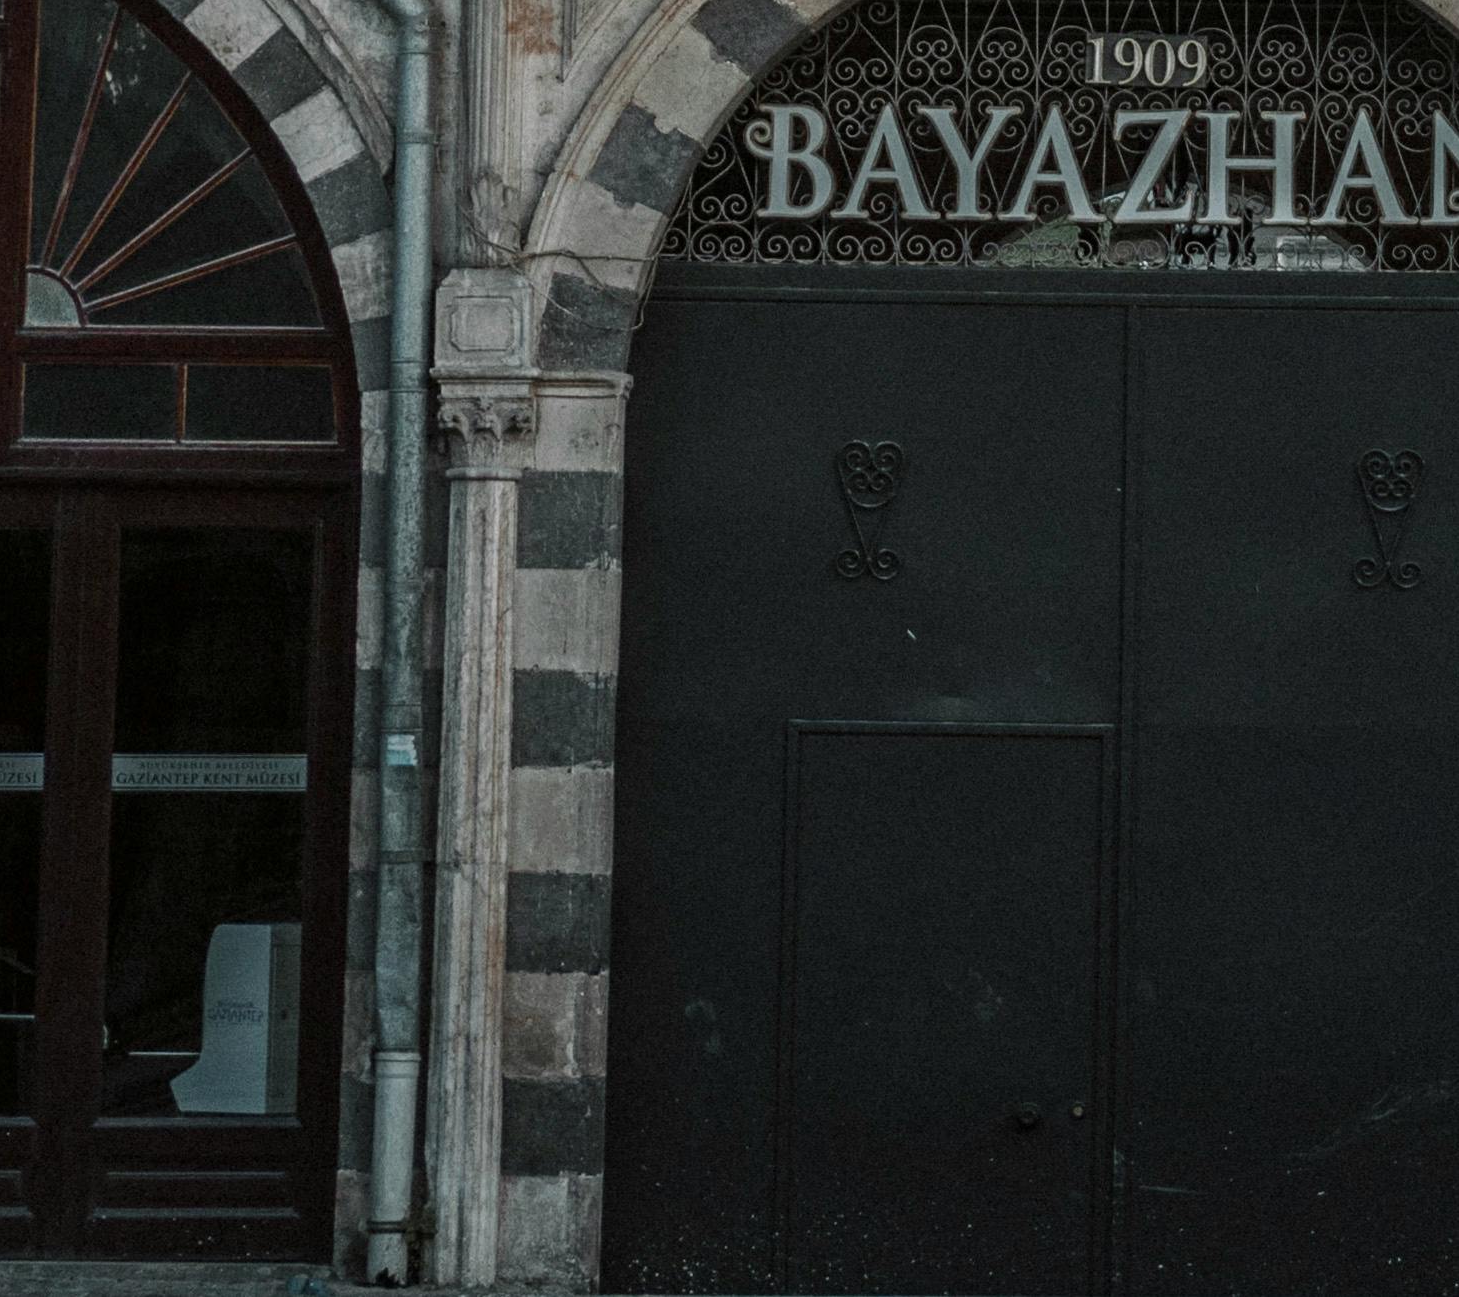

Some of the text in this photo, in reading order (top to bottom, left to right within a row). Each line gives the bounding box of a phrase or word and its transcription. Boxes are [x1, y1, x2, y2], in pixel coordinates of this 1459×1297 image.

[1090, 36, 1209, 86] 1909
[116, 772, 301, 785] GAZİANTEP KENT MÜZESİ
